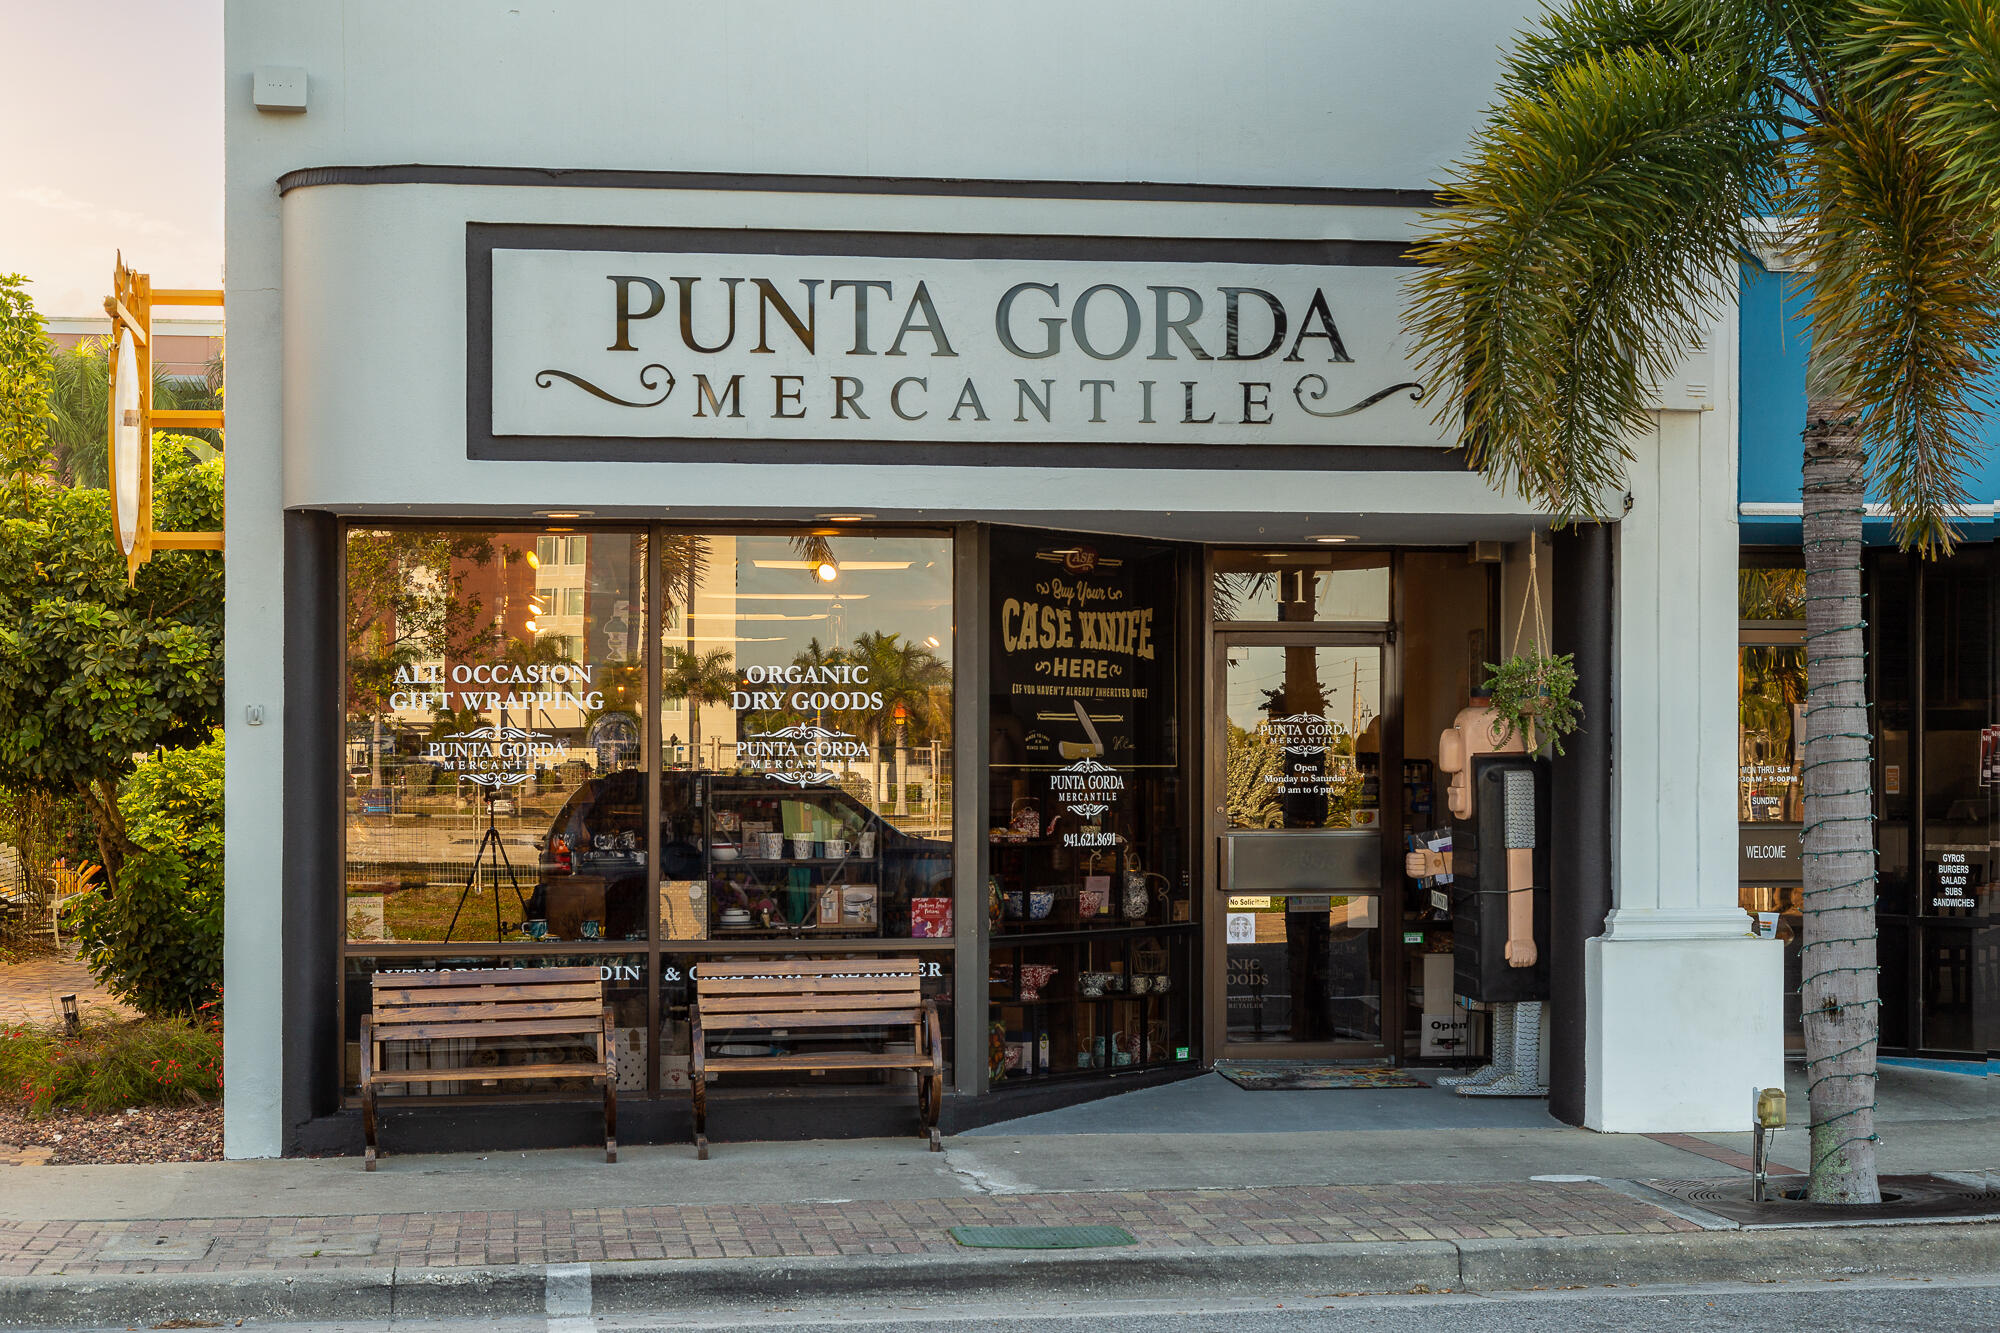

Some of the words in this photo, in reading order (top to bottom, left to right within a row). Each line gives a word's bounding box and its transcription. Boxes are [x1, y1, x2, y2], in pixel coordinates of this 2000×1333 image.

[606, 275, 959, 358] PUNTA
[995, 281, 1355, 364] GORDA
[692, 374, 1274, 426] MERCANTILE
[1066, 547, 1095, 569] CASE
[1052, 578, 1075, 606] Buy
[1076, 580, 1106, 607] Your
[1274, 569, 1334, 606] 117
[1002, 598, 1074, 653] CASE
[1078, 607, 1155, 660] KNIFE
[393, 665, 446, 684] ALL
[452, 665, 593, 684] OCCASION
[746, 665, 869, 684] ORGANIC
[1053, 657, 1109, 678] HERE
[1024, 684, 1035, 695] YOU
[1037, 685, 1064, 696] HAVEN'T
[1066, 686, 1094, 697] ALREADY
[1095, 687, 1130, 698] INHERITED
[389, 691, 454, 711] GIFT
[460, 691, 605, 711] WRAPPING
[731, 691, 786, 711] DRY
[791, 691, 883, 711] GOODS
[1260, 725, 1302, 736] PUNTA
[1306, 725, 1350, 736] GORDA
[429, 742, 492, 758] PUNTA
[499, 742, 566, 758] GORDA
[736, 741, 798, 757] PUNTA
[804, 741, 870, 757] GORDA
[444, 760, 553, 770] MERCANTILE
[751, 760, 856, 769] MERCANTILE
[1294, 764, 1318, 774] Open
[1741, 766, 1756, 774] MON
[1757, 766, 1775, 774] THRU
[1050, 775, 1085, 790] PUNTA
[1088, 775, 1124, 790] GORDA
[1264, 775, 1298, 785] Monday
[1300, 775, 1309, 783] to
[1310, 775, 1347, 785] Saturday
[1058, 792, 1117, 801] MERCANTILE
[1277, 786, 1286, 794] 10
[1303, 786, 1311, 794] to
[1313, 786, 1319, 794] 6
[1320, 787, 1335, 796] pm
[1752, 797, 1778, 805] SUNDAY
[1064, 833, 1116, 847] 941.621.8691
[1746, 845, 1786, 859] WELCOME
[1942, 854, 1965, 863] GYROS
[1938, 865, 1969, 874] BURGERS
[1941, 876, 1967, 885] SALADS
[1945, 887, 1963, 896] SUBS
[1933, 898, 1975, 908] SANDWICHES
[664, 967, 681, 981] &
[1431, 1021, 1467, 1032] Open
